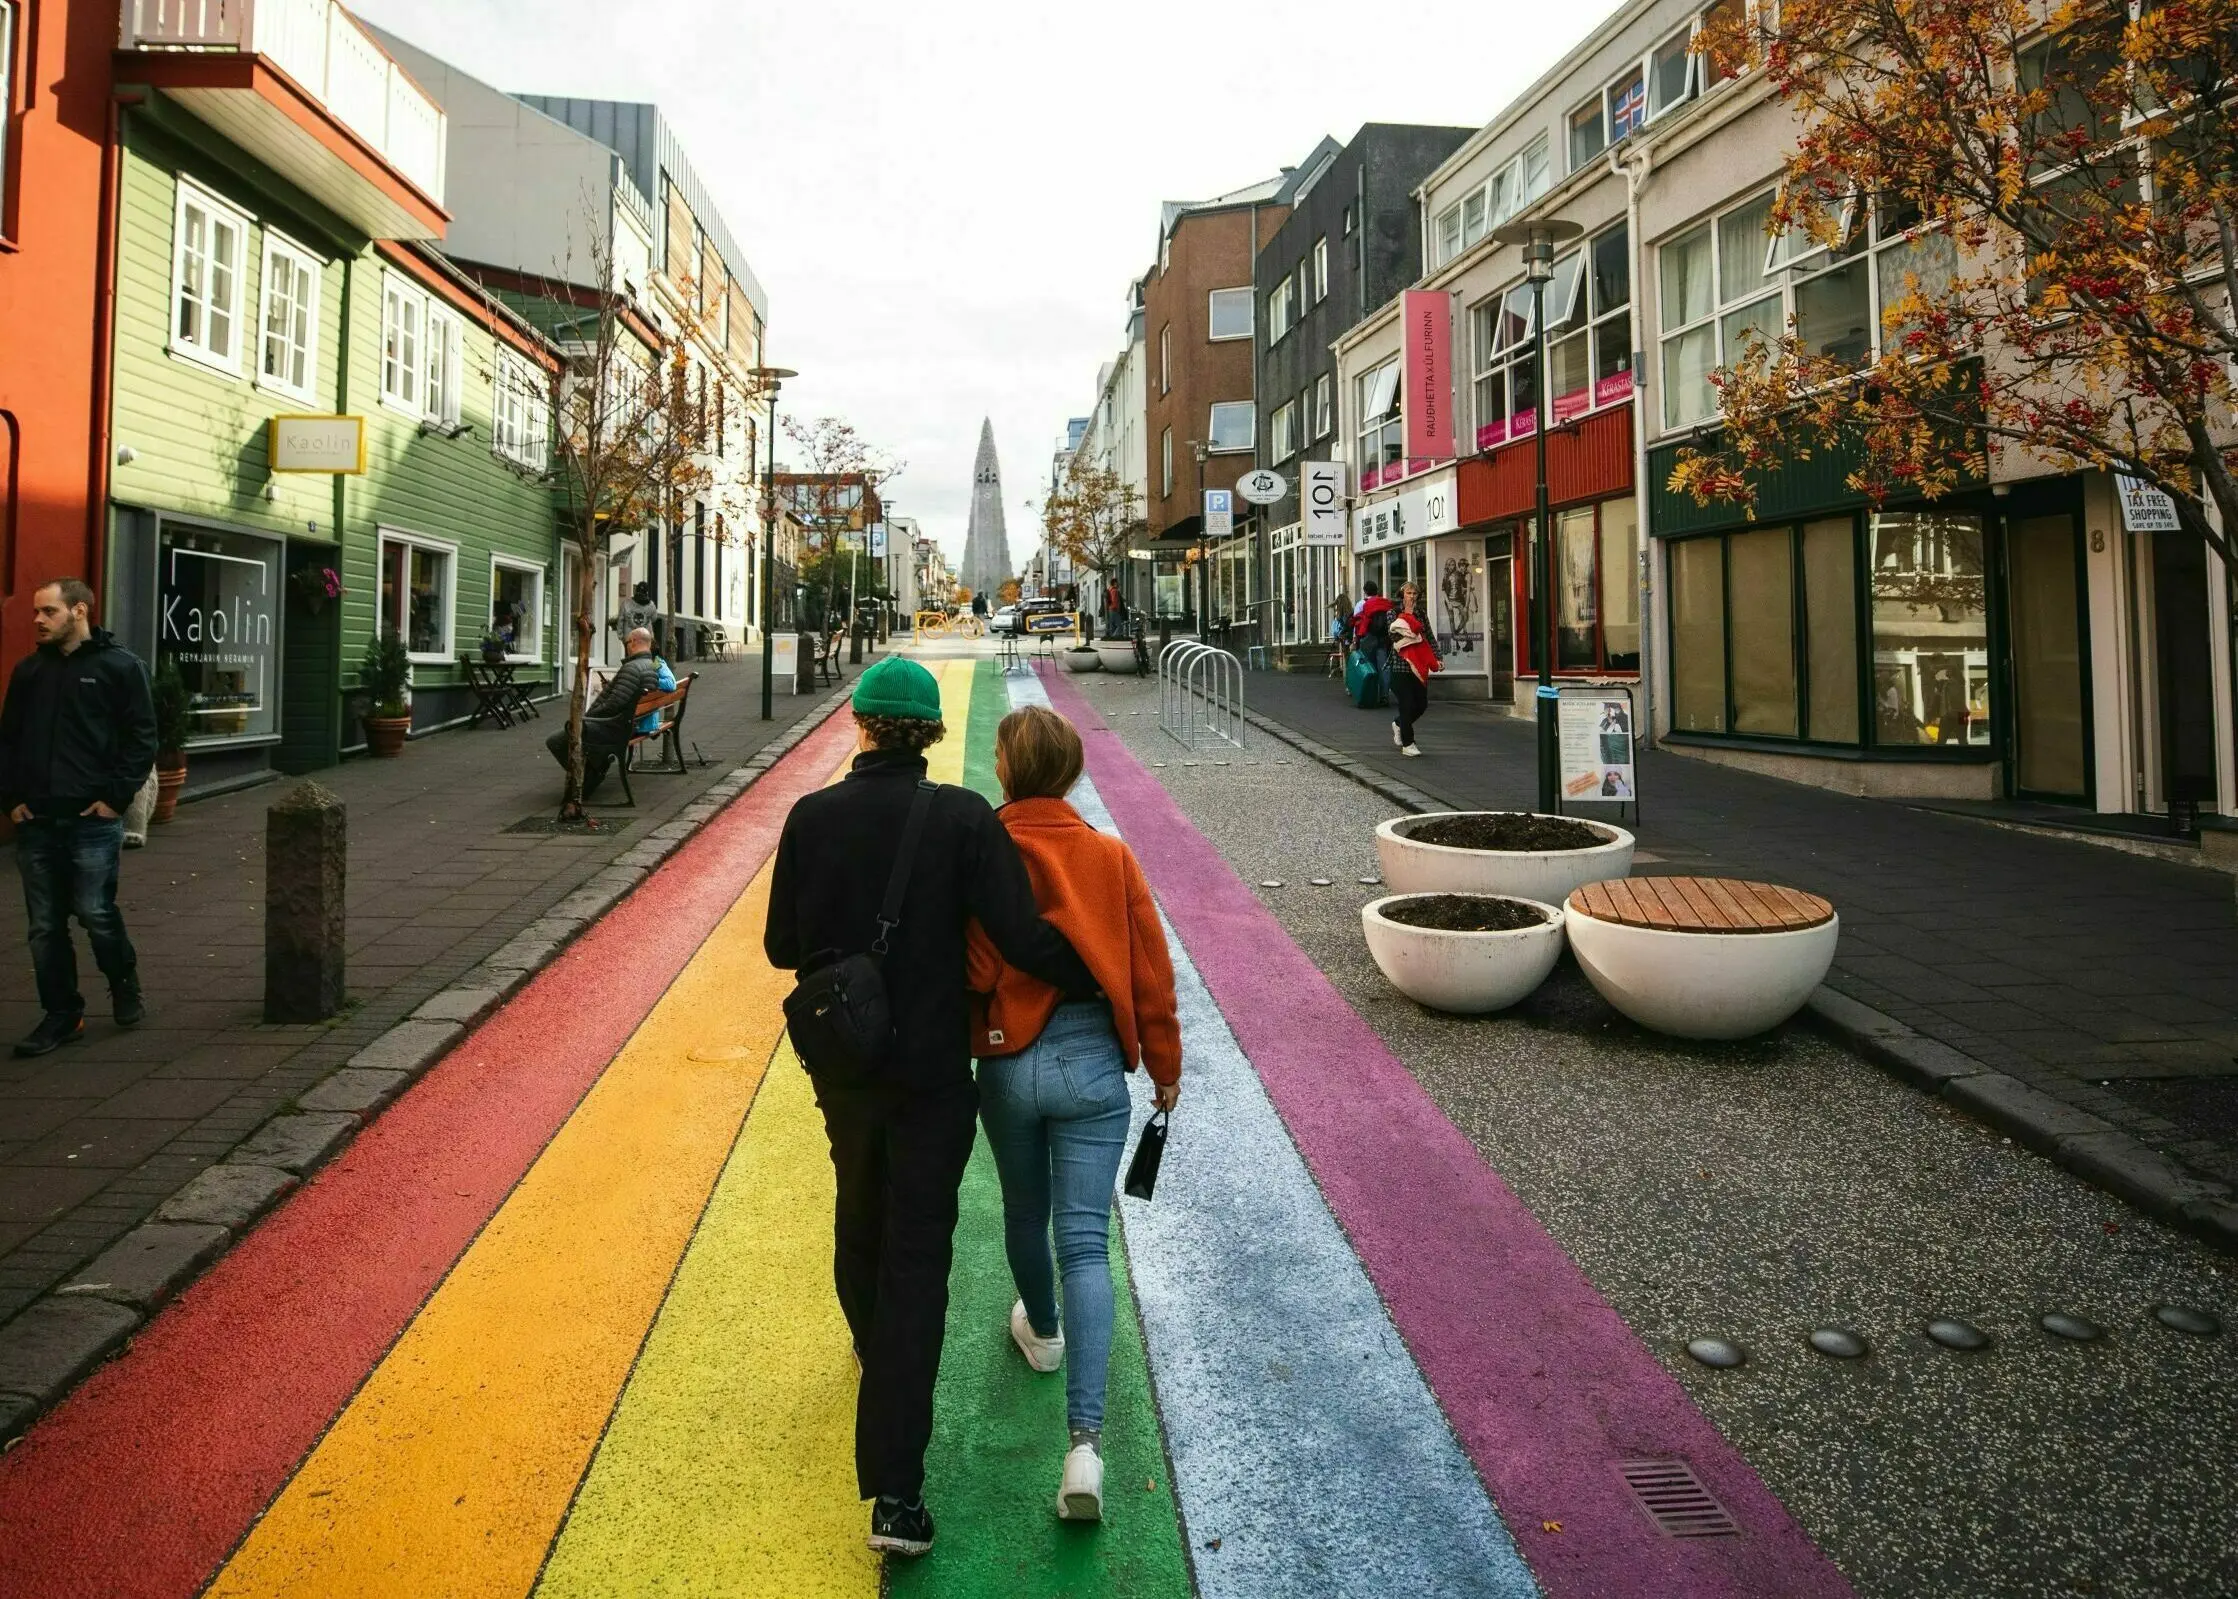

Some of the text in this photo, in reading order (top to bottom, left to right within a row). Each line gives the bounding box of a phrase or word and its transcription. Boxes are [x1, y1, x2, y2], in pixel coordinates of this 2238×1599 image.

[286, 434, 351, 451] Kaolin
[1312, 470, 1334, 520] 101
[2126, 494, 2168, 507] TAX FREE
[1426, 495, 1445, 522] 101
[2129, 508, 2172, 521] SHOPPING
[2090, 529, 2105, 554] 8
[162, 593, 271, 645] Kaolin
